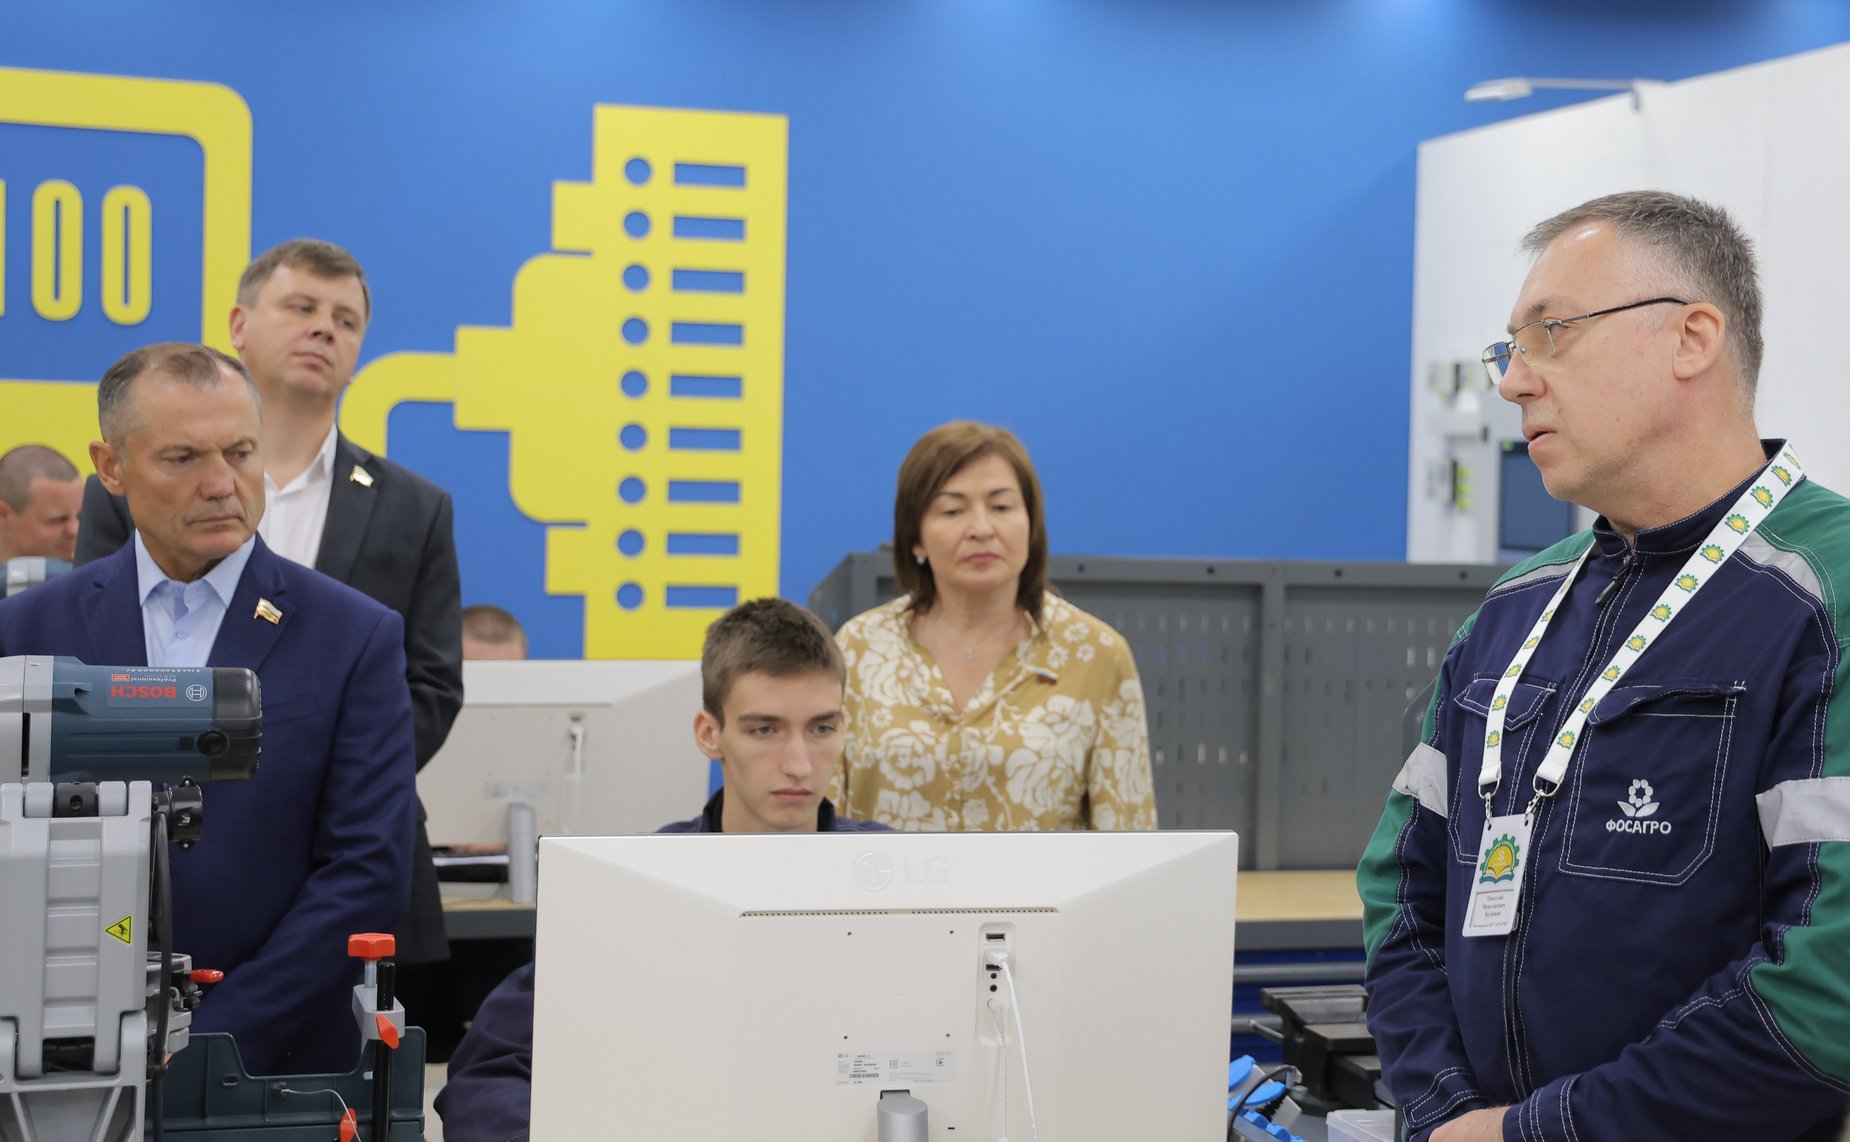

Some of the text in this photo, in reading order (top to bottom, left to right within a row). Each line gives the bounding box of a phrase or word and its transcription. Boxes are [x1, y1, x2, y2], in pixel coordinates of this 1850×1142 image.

[111, 685, 176, 698] BOSCH
[1605, 819, 1672, 834] ФОСАГРО
[904, 856, 951, 885] LG
